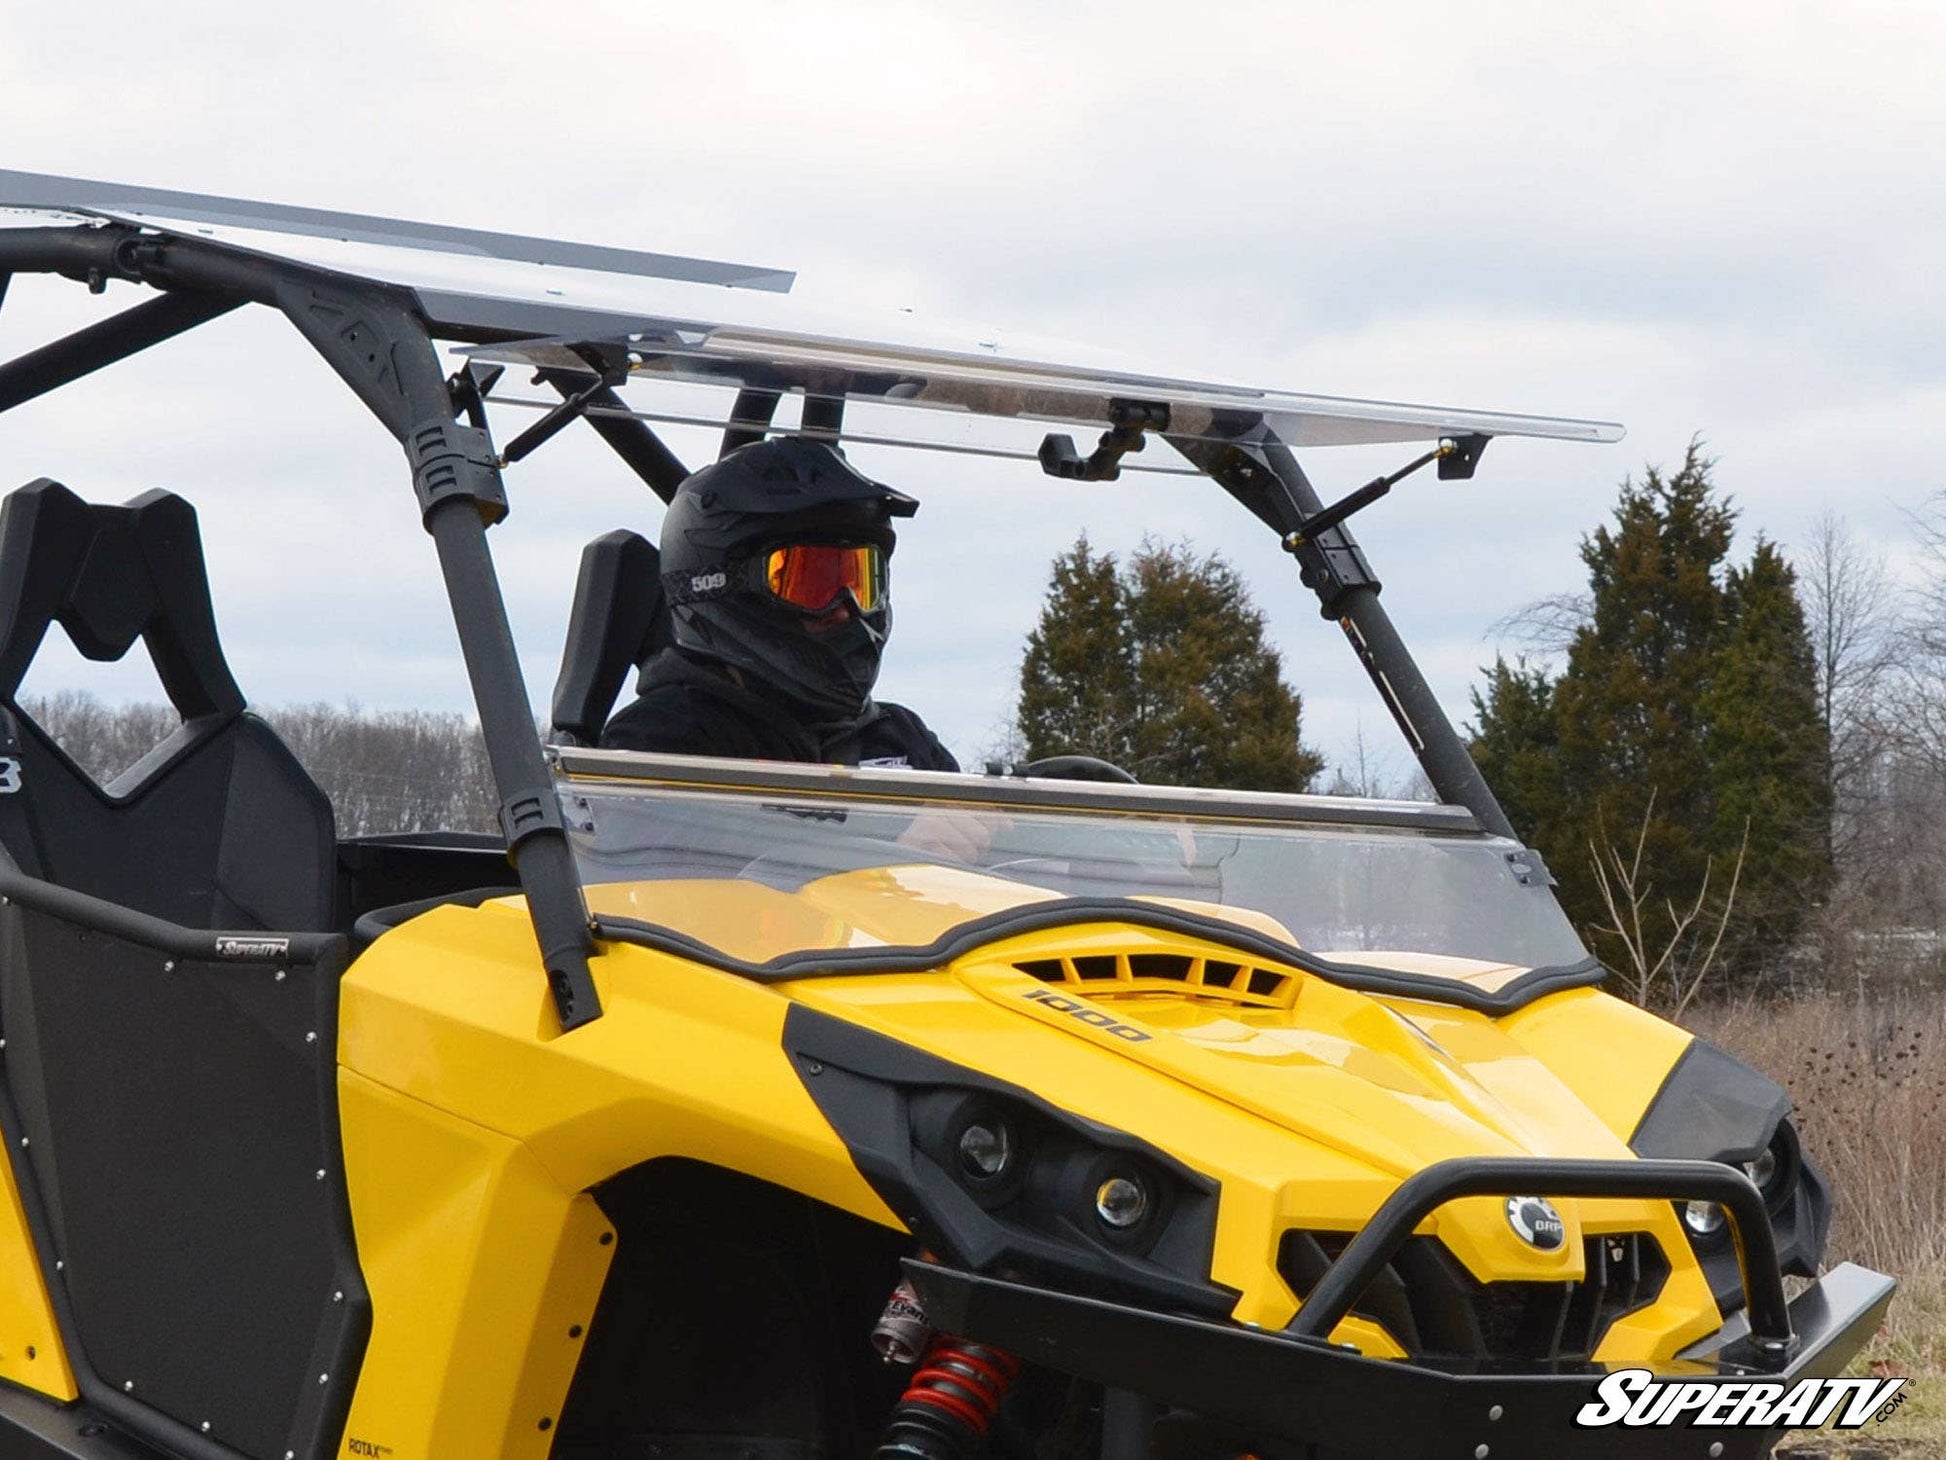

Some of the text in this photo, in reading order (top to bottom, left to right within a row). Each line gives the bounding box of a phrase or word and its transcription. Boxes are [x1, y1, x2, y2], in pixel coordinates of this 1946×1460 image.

[691, 573, 727, 592] 509
[1021, 989, 1153, 1042] 1000
[349, 1438, 380, 1459] ROTAX
